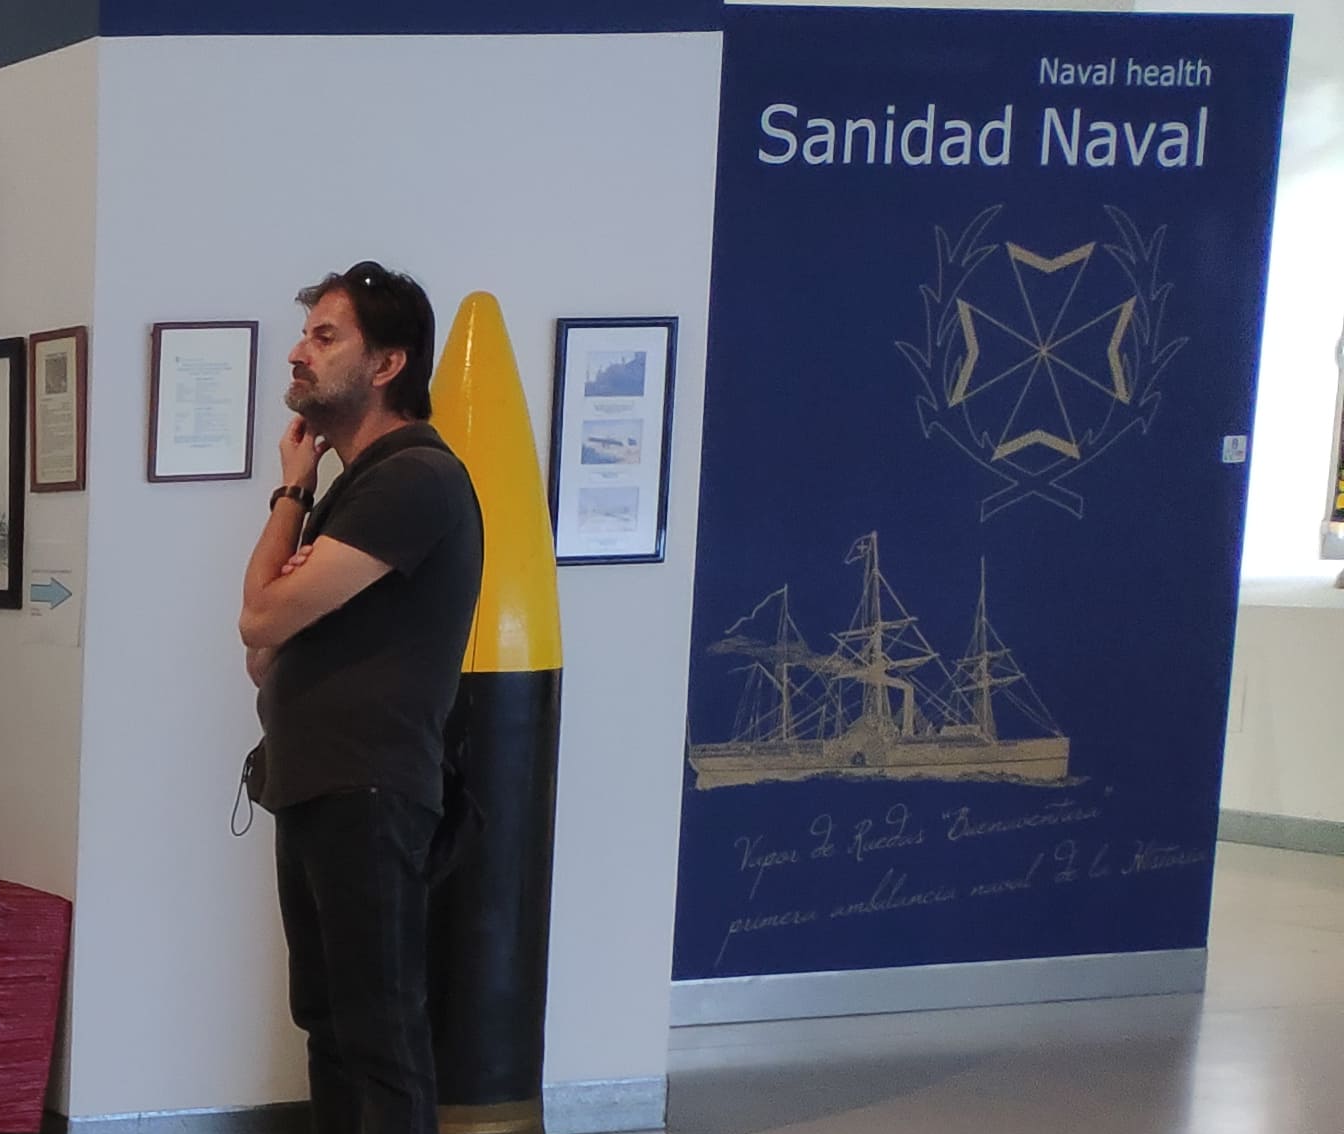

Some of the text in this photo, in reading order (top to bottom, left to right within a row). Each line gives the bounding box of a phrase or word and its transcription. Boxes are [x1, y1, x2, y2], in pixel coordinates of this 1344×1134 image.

[1039, 56, 1212, 87] Naval health
[758, 102, 1209, 167] Sanidad Naval
